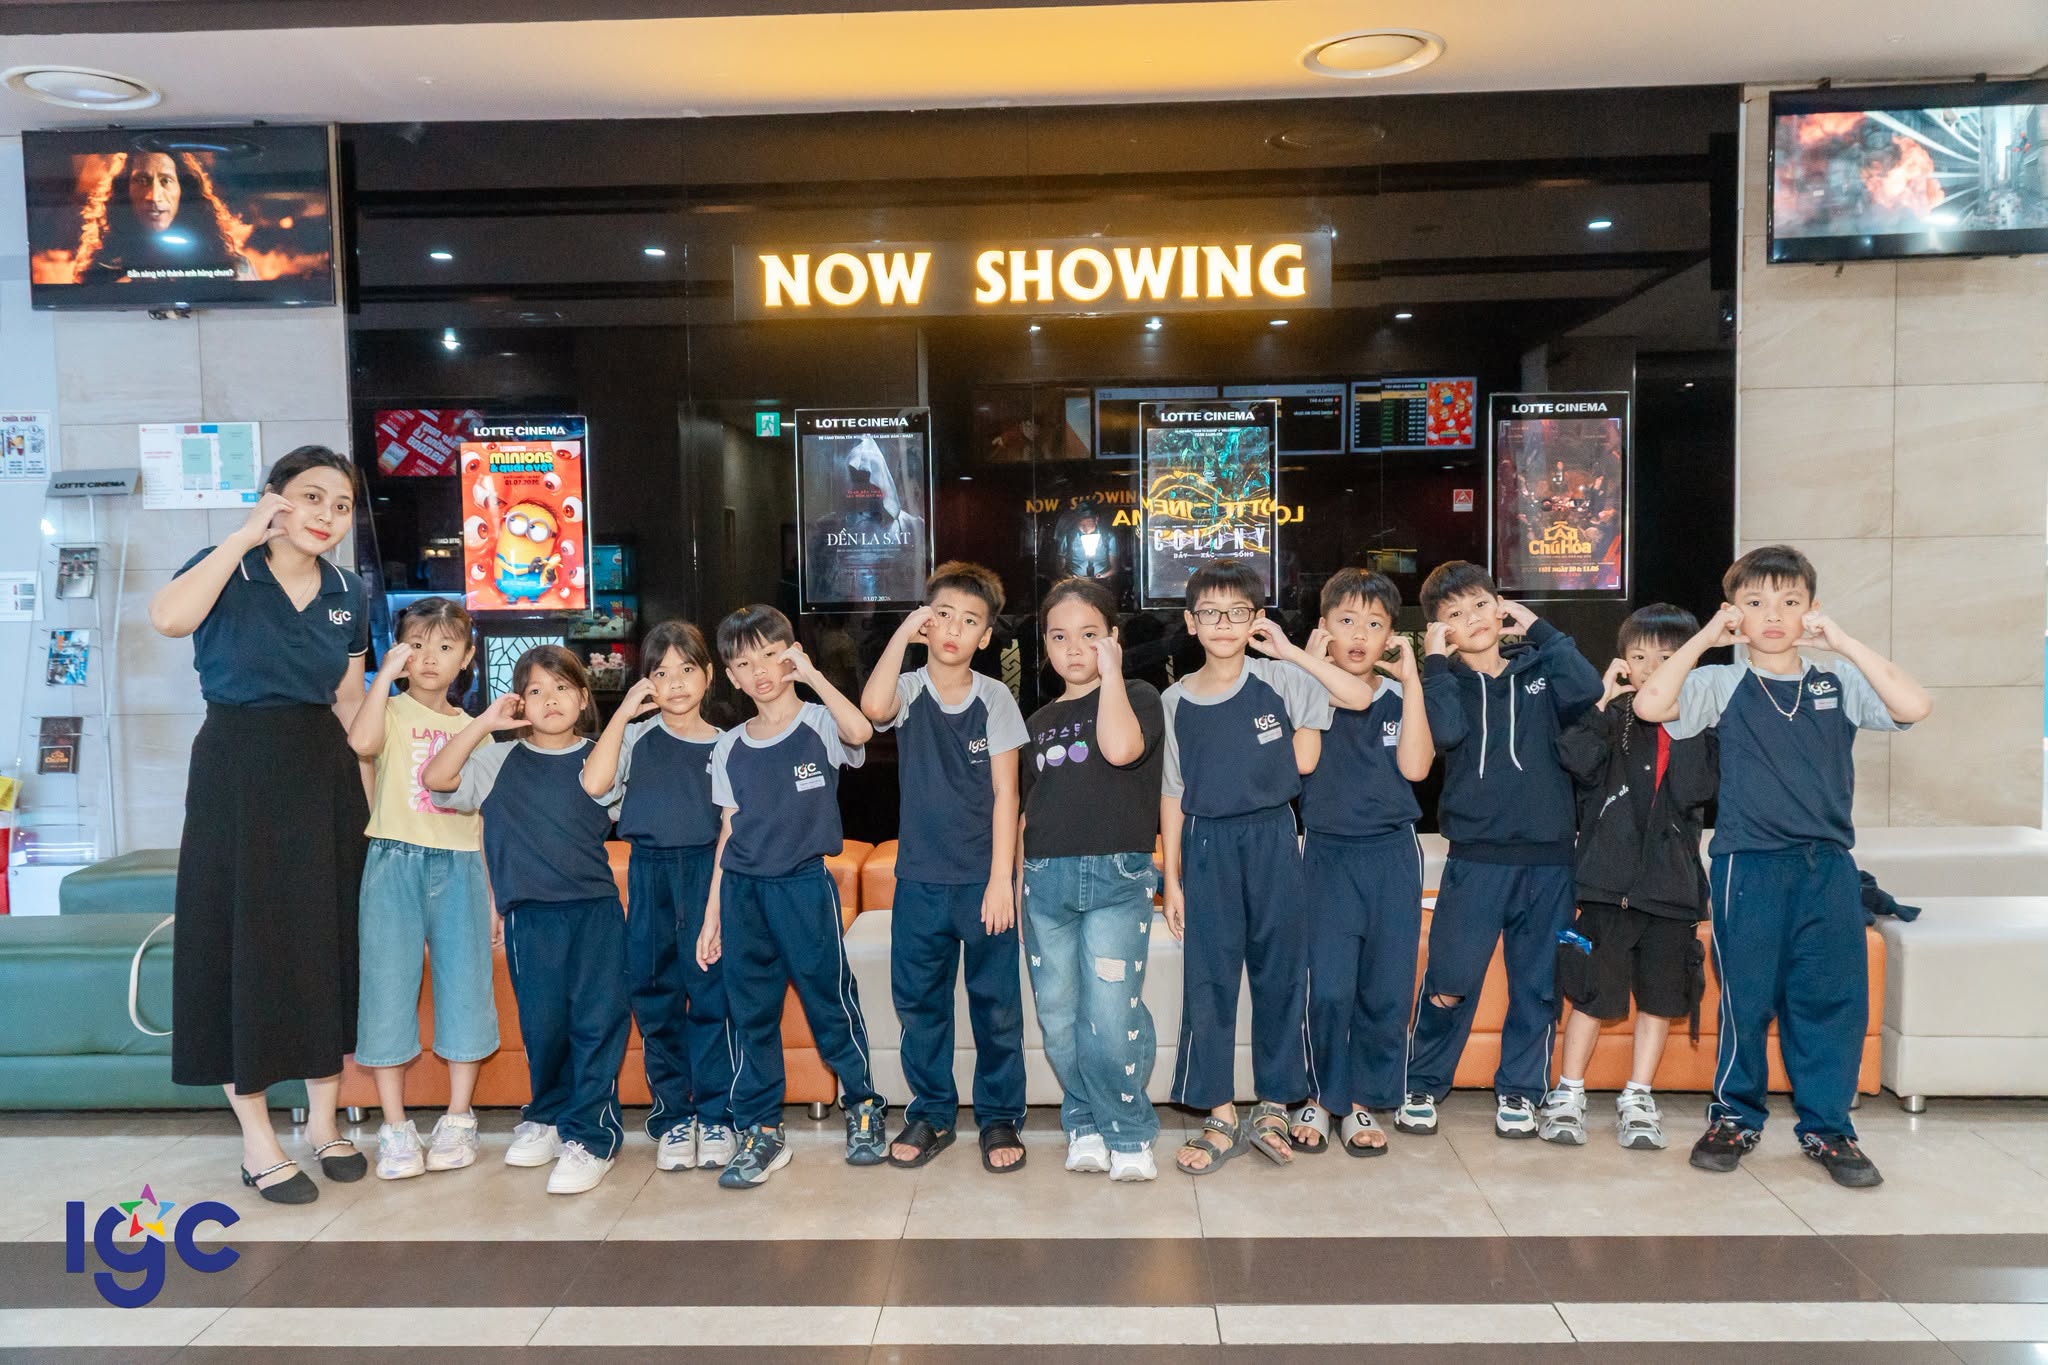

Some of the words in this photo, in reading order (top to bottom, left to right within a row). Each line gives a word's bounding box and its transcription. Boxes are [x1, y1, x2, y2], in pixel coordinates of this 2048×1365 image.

[758, 252, 932, 306] NOW
[975, 244, 1306, 302] SHOWING
[1511, 404, 1554, 413] LOTTE
[1555, 402, 1608, 412] CINEMA
[815, 419, 856, 428] LOTTE
[857, 417, 909, 427] CINEMA
[1161, 413, 1201, 422] LOTTE
[1203, 411, 1255, 421] CINEMA
[473, 427, 513, 436] LOTTE
[515, 426, 566, 436] CINEMA
[827, 528, 858, 546] ĐỀN
[862, 533, 879, 545] LA
[1301, 1107, 1316, 1123] G
[1356, 1111, 1372, 1127] G
